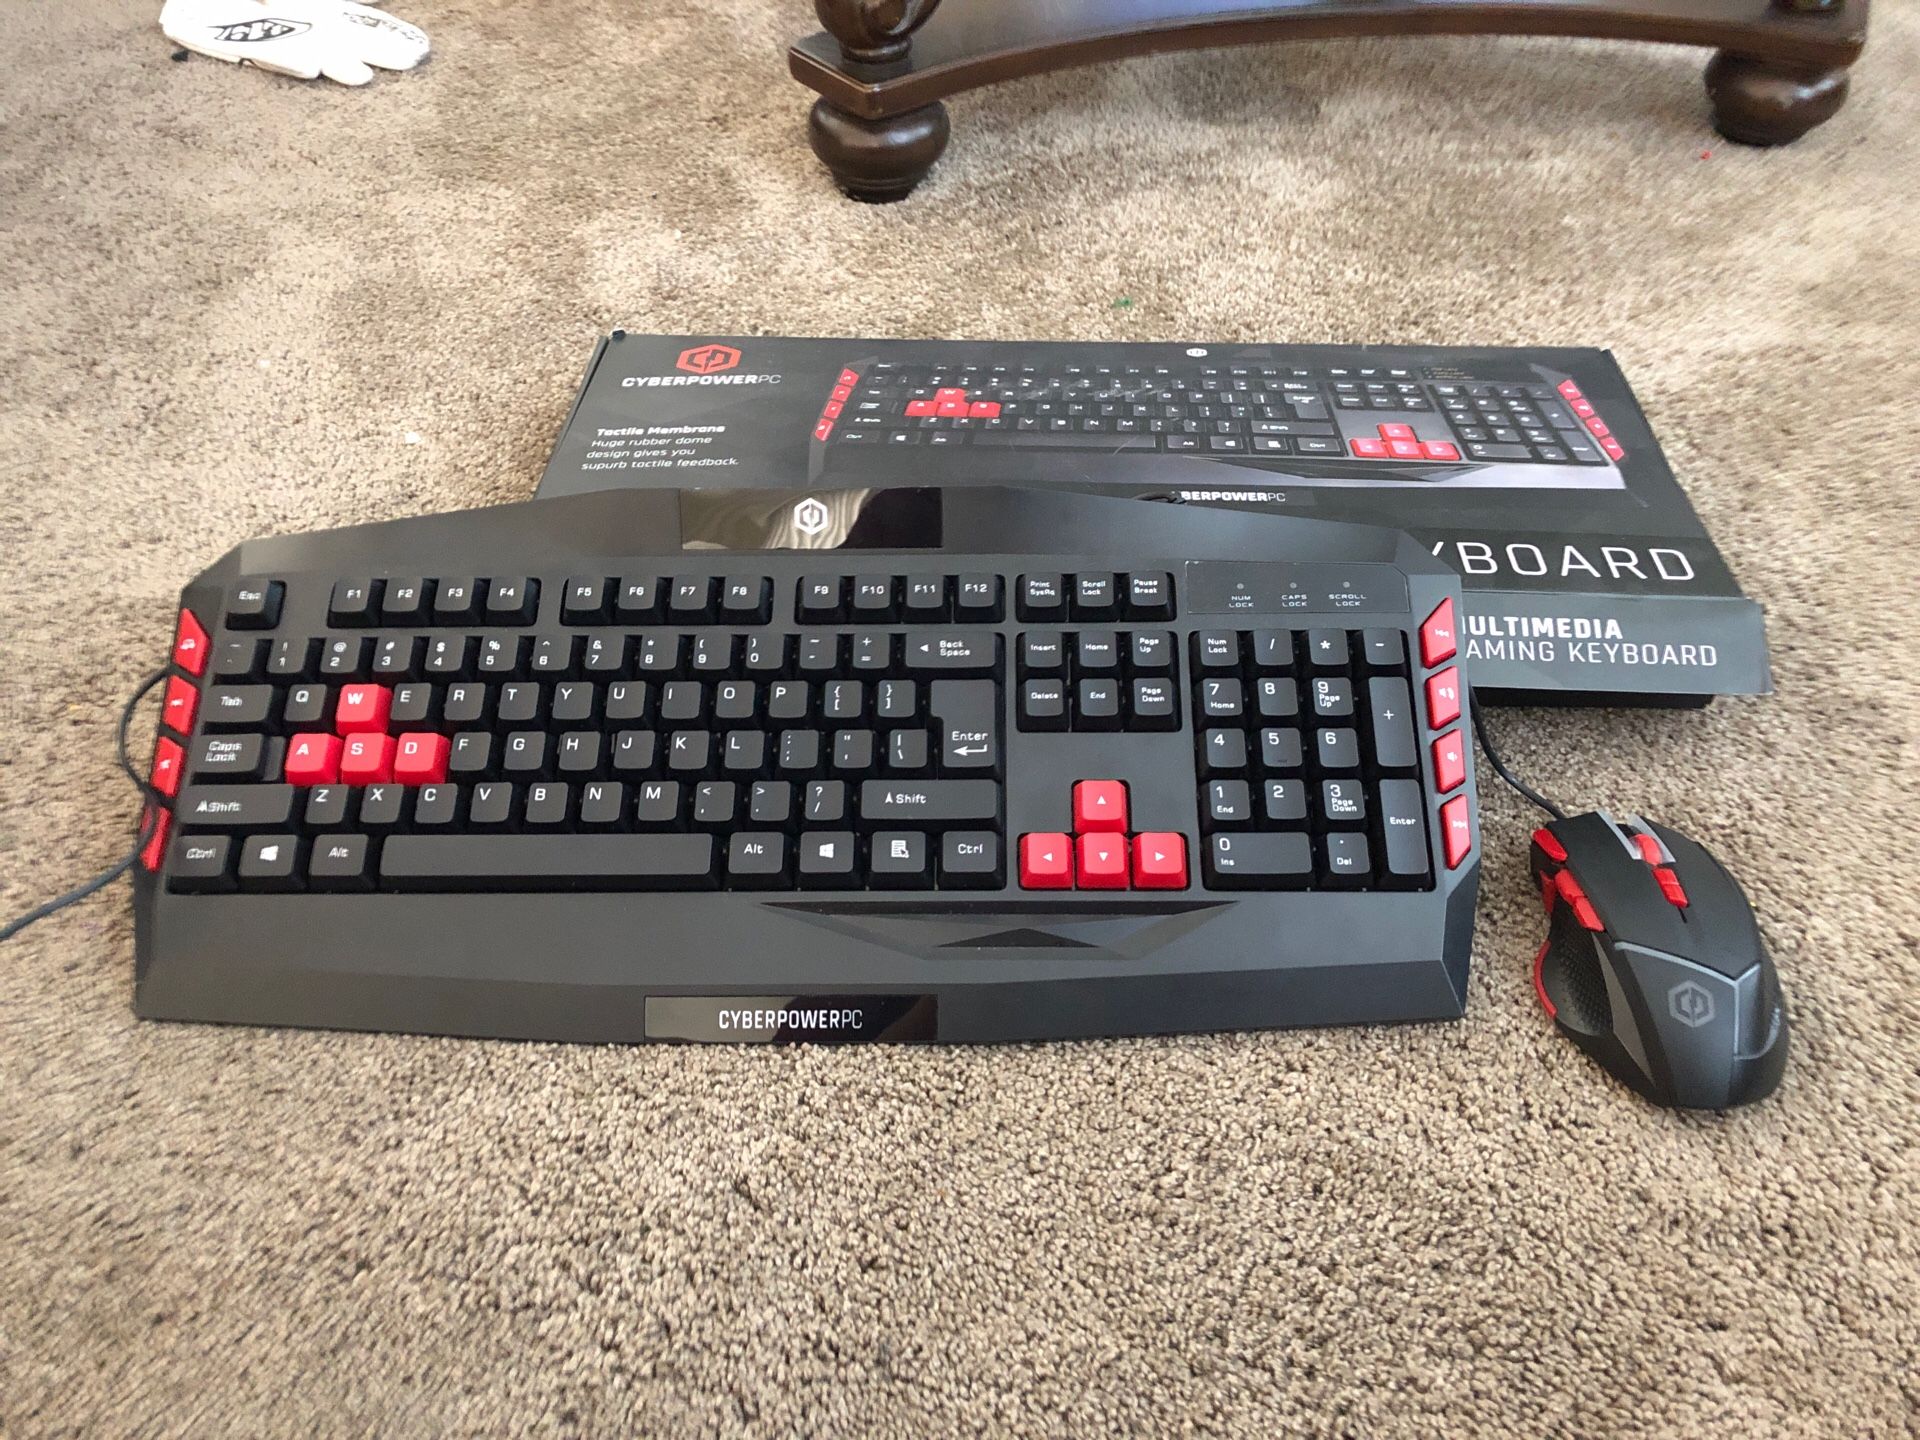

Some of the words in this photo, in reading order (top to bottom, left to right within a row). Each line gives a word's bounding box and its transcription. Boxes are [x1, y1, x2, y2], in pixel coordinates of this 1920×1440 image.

[622, 375, 781, 387] CYBERPOWERPC
[598, 427, 644, 436] Tactile
[648, 426, 725, 434] Membrane
[592, 439, 625, 448] Huge
[587, 450, 630, 458] design
[634, 449, 667, 458] gives
[582, 461, 627, 470] supurb
[677, 458, 738, 466] feedback.
[1180, 491, 1285, 501] BERPOWERPC
[1432, 542, 1694, 580] BOARD
[965, 584, 987, 592] F12
[1134, 579, 1157, 588] Pause
[347, 590, 361, 598] F1
[398, 589, 413, 598] F2
[448, 588, 463, 597] F3
[500, 588, 514, 596] F4
[577, 588, 591, 596] F5
[629, 587, 644, 595] F6
[681, 587, 695, 595] F7
[733, 587, 747, 595] F8
[815, 586, 828, 594] F9
[862, 586, 884, 594] F10
[915, 585, 935, 593] F11
[1462, 616, 1623, 641] ULTIMEDIA
[334, 642, 346, 652] @
[489, 641, 500, 650] %
[593, 640, 602, 649] &
[940, 640, 963, 649] Back
[1140, 644, 1152, 653] Up
[1270, 639, 1275, 649] /
[940, 647, 970, 656] Space
[1466, 639, 1554, 661] AMING
[1569, 642, 1717, 666] KEYBOARD
[280, 657, 285, 666] 1
[330, 657, 340, 666] 2
[382, 656, 391, 665] 3
[434, 657, 442, 666] 4
[486, 656, 494, 665] 5
[540, 656, 547, 665] 6
[592, 655, 599, 664] 7
[645, 654, 653, 664] 8
[699, 654, 706, 663] 9
[724, 687, 735, 699] O
[776, 687, 786, 698] P
[1142, 687, 1161, 696] Page
[1210, 683, 1219, 695] 7
[1265, 683, 1275, 694] 8
[1318, 681, 1328, 695] 9
[296, 691, 309, 702] Q
[348, 693, 363, 704] W
[400, 691, 411, 702] E
[454, 690, 464, 701] R
[508, 689, 517, 700] T
[562, 688, 572, 699] Y
[614, 688, 625, 699] U
[1142, 694, 1164, 702] Down
[1319, 694, 1340, 703] Page
[1320, 698, 1333, 707] Up
[1384, 710, 1394, 720] +
[952, 731, 988, 740] Enter
[1214, 734, 1224, 745] 4
[1269, 733, 1279, 744] 5
[1325, 732, 1336, 744] 6
[209, 741, 242, 752] Caps
[405, 742, 417, 754] D
[459, 739, 468, 750] F
[513, 738, 525, 750] G
[567, 738, 578, 750] H
[622, 737, 632, 749] J
[676, 737, 686, 749] K
[731, 737, 740, 749] L
[296, 744, 309, 755] A
[351, 743, 363, 755] S
[206, 751, 236, 761] Lock
[316, 790, 329, 802] Z
[370, 789, 383, 801] X
[425, 789, 436, 801] C
[480, 788, 491, 800] V
[535, 788, 546, 800] B
[590, 787, 601, 800] N
[646, 787, 661, 799] M
[816, 787, 823, 796] ?
[1216, 786, 1223, 798] 1
[1273, 785, 1284, 798] 2
[1330, 785, 1341, 799] 3
[896, 794, 926, 803] Shift
[1332, 798, 1355, 808] Page
[1217, 805, 1233, 813] End
[1390, 817, 1416, 825] Enter
[744, 844, 763, 854] Alt
[958, 844, 982, 854] Ctrl
[1219, 838, 1230, 850] 0
[1337, 857, 1352, 865] Del
[719, 1008, 862, 1029] CYBERPOWERPC
